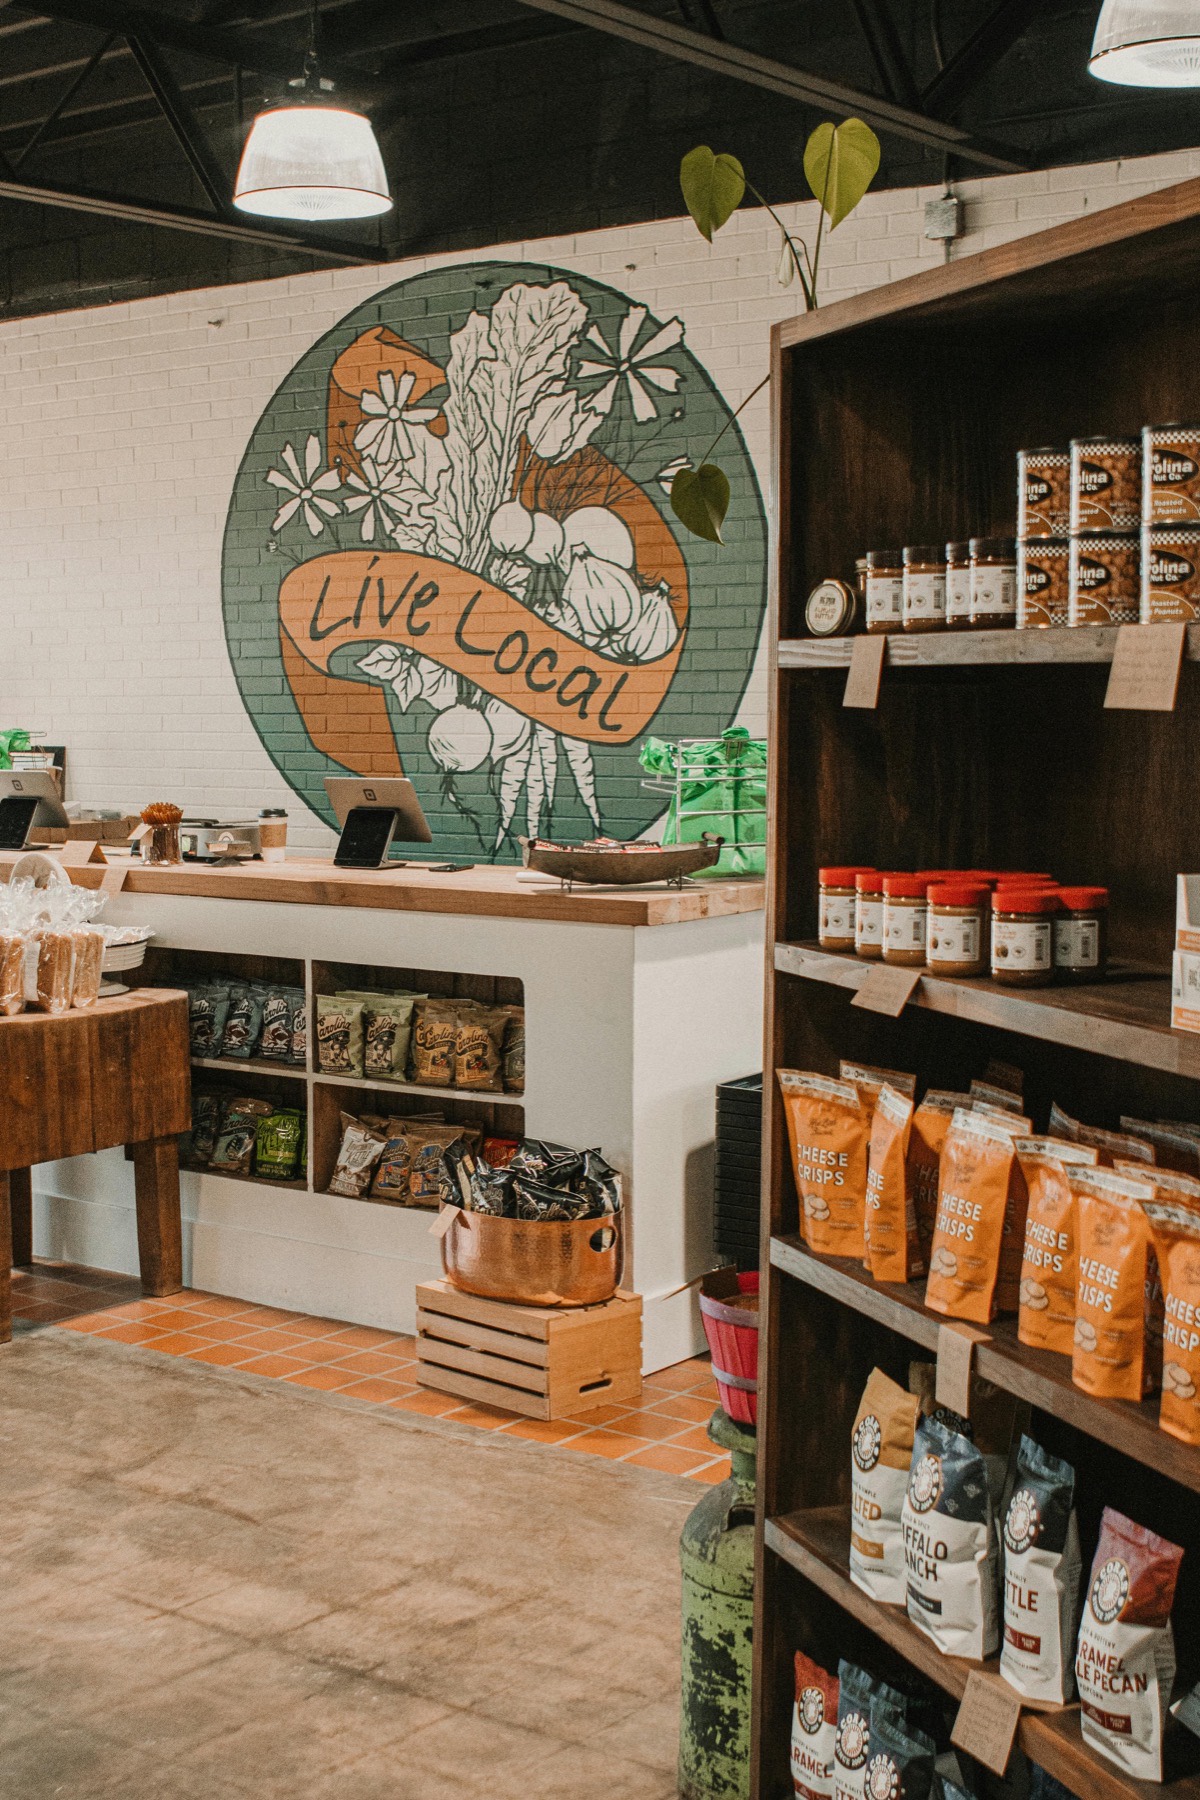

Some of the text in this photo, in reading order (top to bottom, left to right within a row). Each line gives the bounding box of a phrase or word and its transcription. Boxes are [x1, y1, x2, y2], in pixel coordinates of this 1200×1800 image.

[310, 555, 630, 732] Live Local
[318, 1015, 352, 1038] Carolina
[366, 1017, 398, 1039] Carolina
[458, 1028, 489, 1047] Carolina
[797, 1163, 845, 1186] CRISPS
[1026, 1218, 1069, 1251] CHEESE
[853, 1491, 882, 1521] LTED
[1093, 1668, 1148, 1694] PECAN
